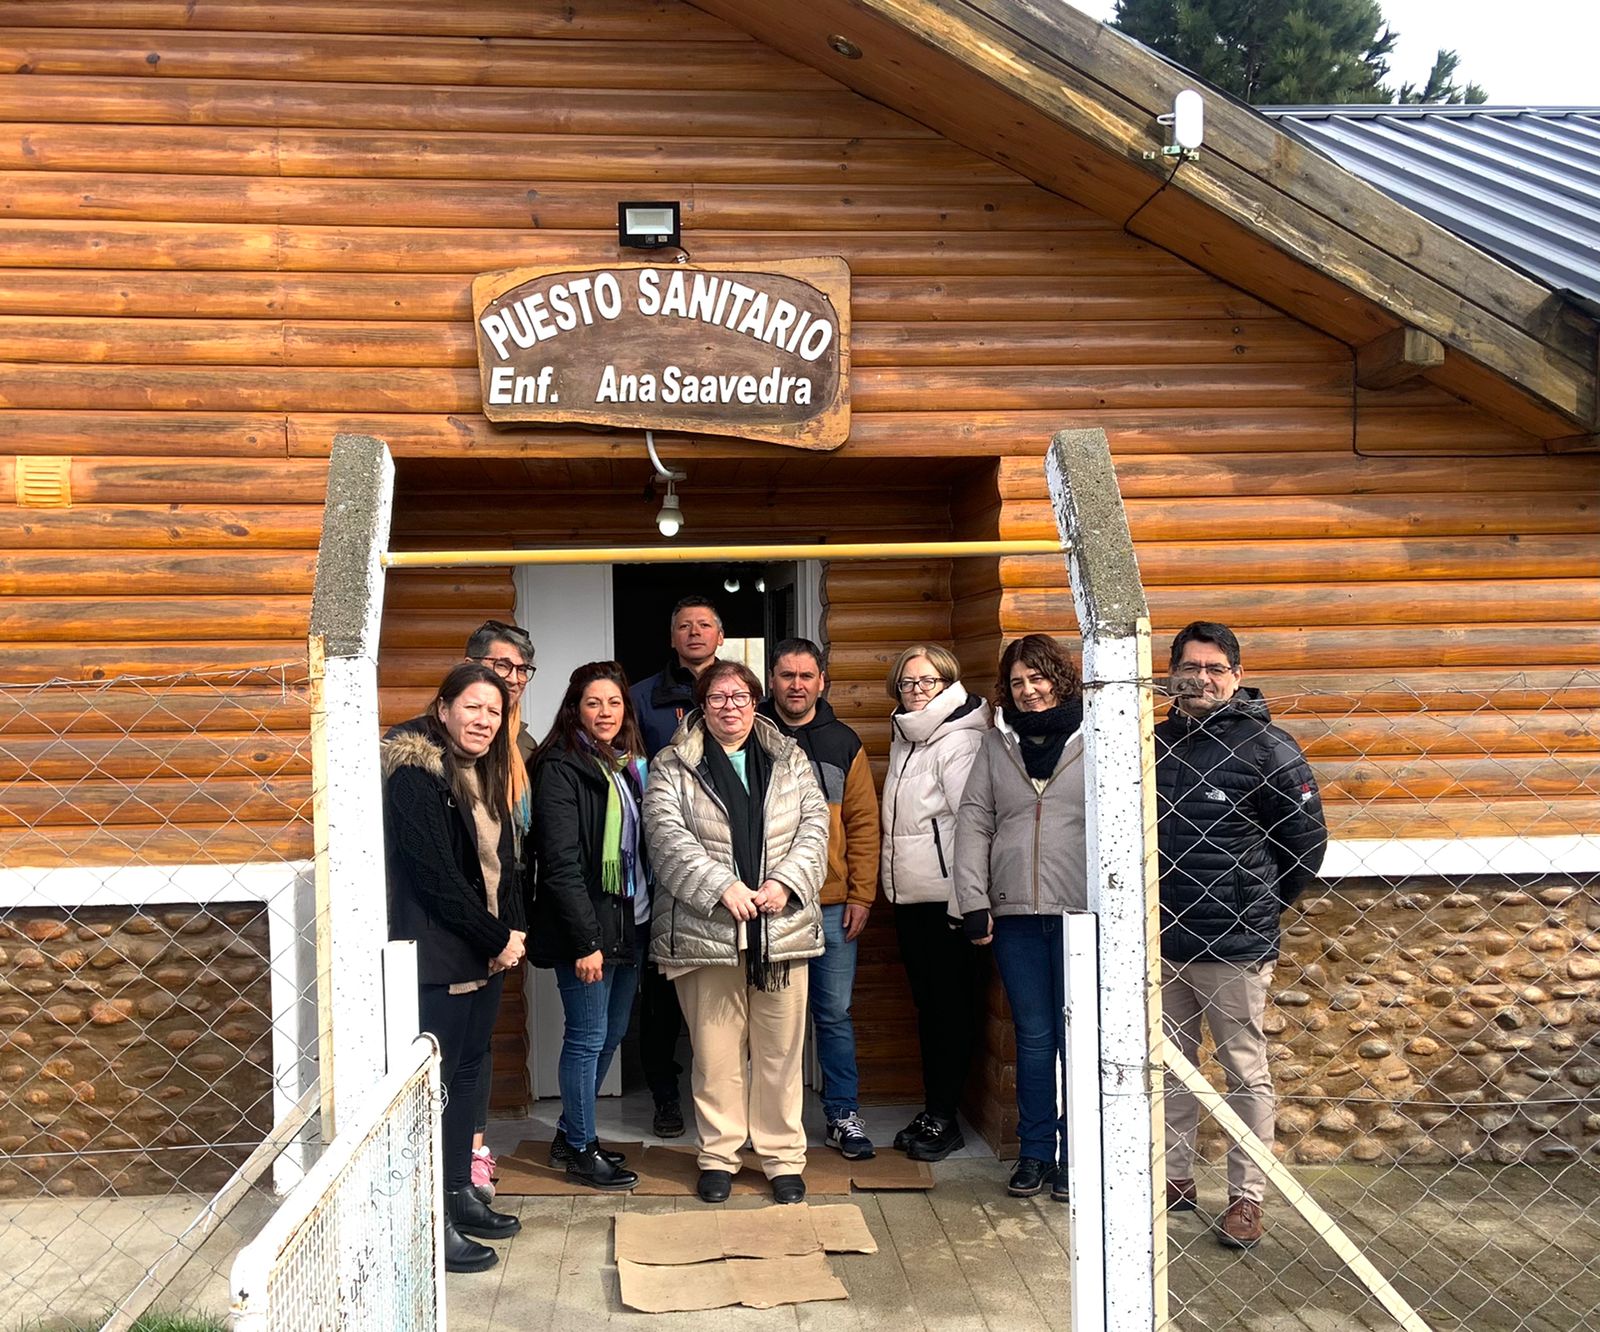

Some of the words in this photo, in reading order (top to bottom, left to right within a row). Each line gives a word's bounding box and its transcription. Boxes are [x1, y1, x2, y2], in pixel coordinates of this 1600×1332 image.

[480, 273, 622, 360] PUESTO
[637, 268, 833, 362] SANITARIO
[488, 366, 559, 405] Enf.
[595, 365, 656, 403] Ana
[661, 366, 812, 405] Saavedra
